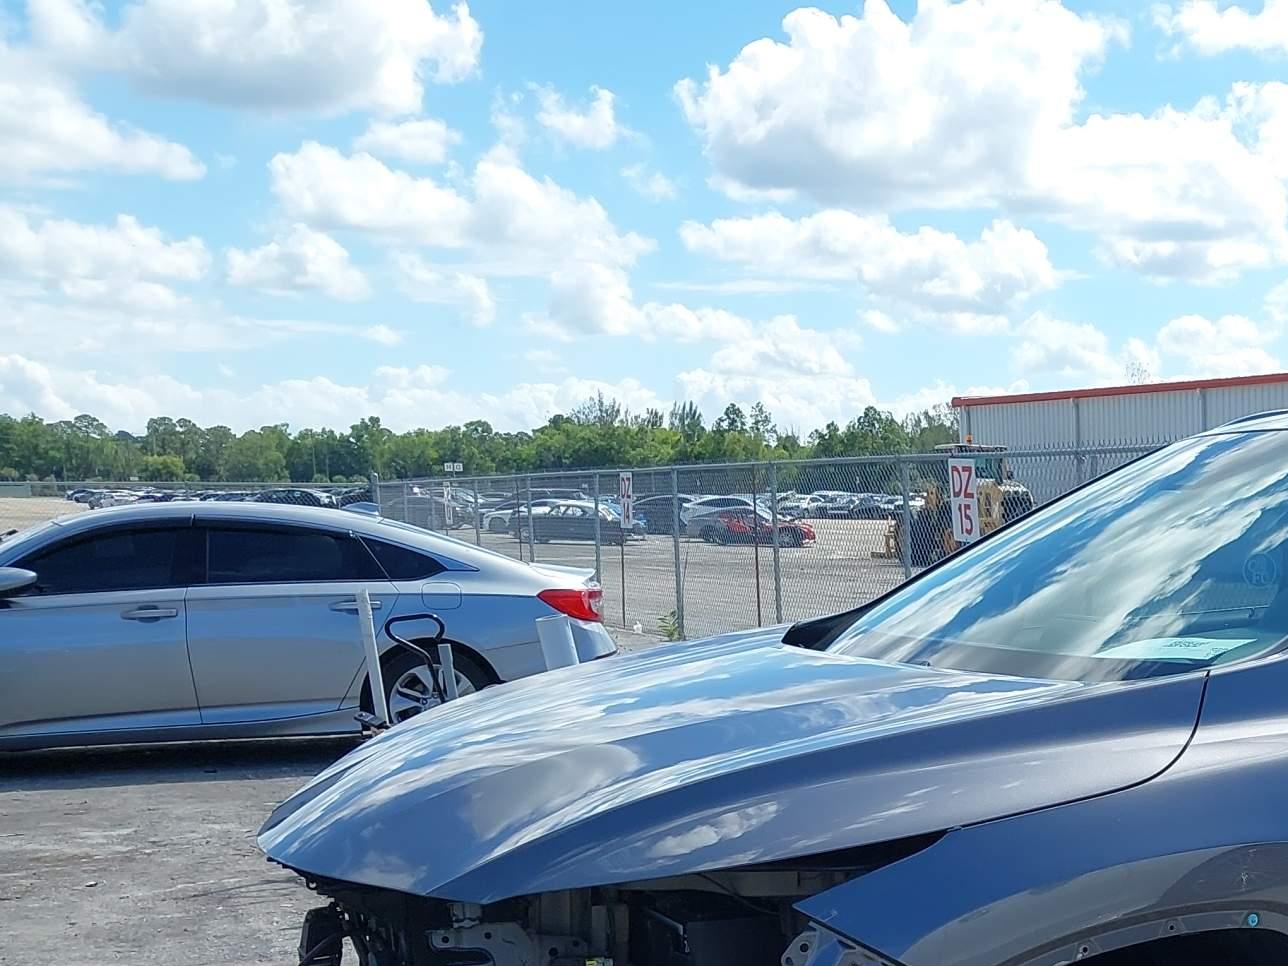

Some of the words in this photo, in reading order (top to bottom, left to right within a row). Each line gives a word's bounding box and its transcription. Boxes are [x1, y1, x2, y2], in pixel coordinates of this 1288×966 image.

[621, 476, 631, 499] DZ
[951, 465, 975, 499] DZ
[623, 502, 630, 524] 14
[957, 503, 974, 536] 15
